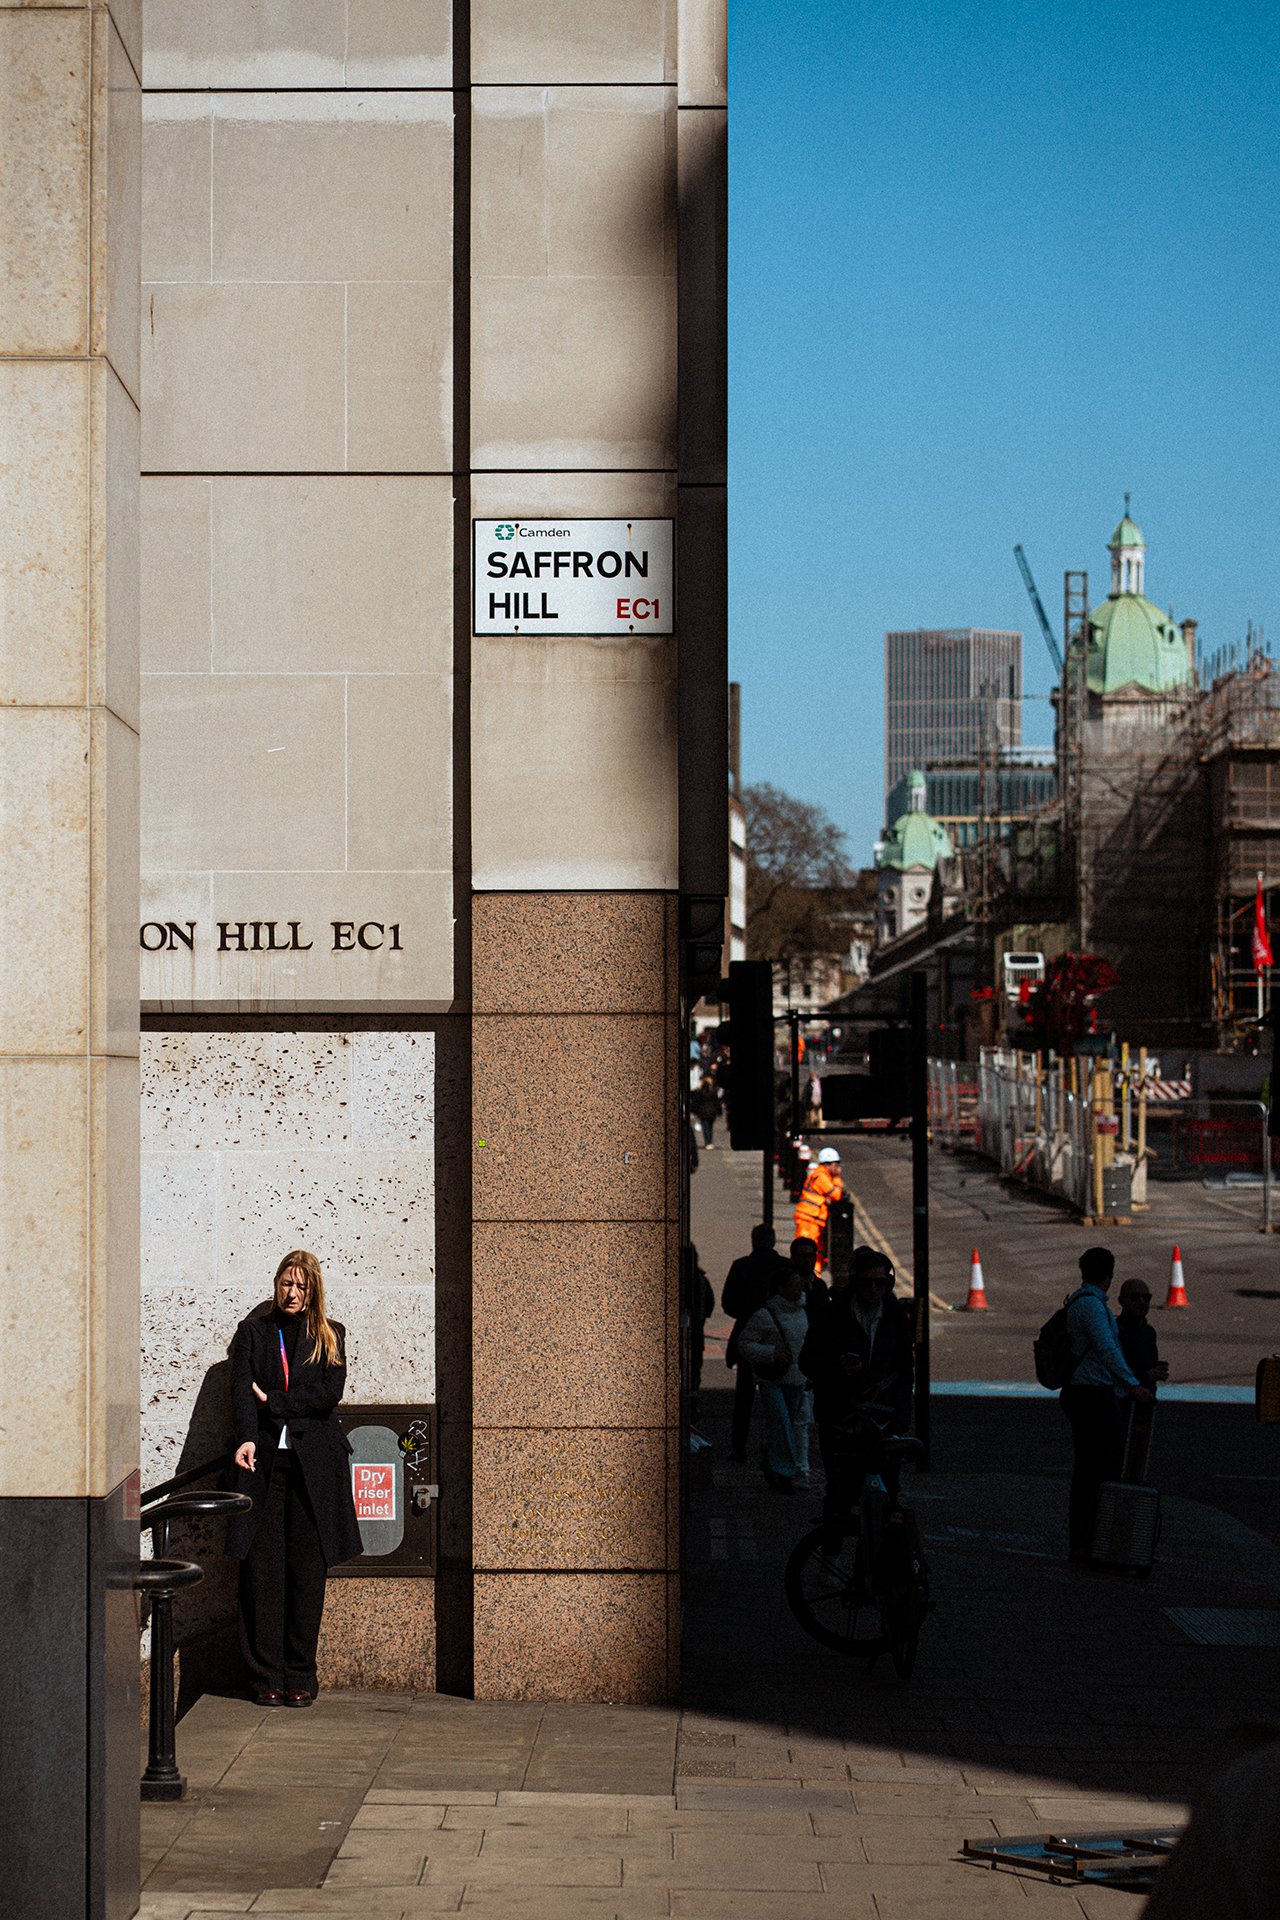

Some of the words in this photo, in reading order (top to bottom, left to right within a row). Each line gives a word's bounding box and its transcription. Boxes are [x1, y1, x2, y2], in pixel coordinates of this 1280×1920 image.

[519, 527, 571, 538] Camden
[487, 550, 648, 578] SAFFRON
[489, 592, 558, 619] HILL
[616, 598, 659, 619] EC1
[216, 921, 313, 951] HILL
[330, 921, 404, 951] EC1
[360, 1469, 385, 1485] Dry
[358, 1487, 391, 1499] riser
[358, 1503, 389, 1515] inlet
